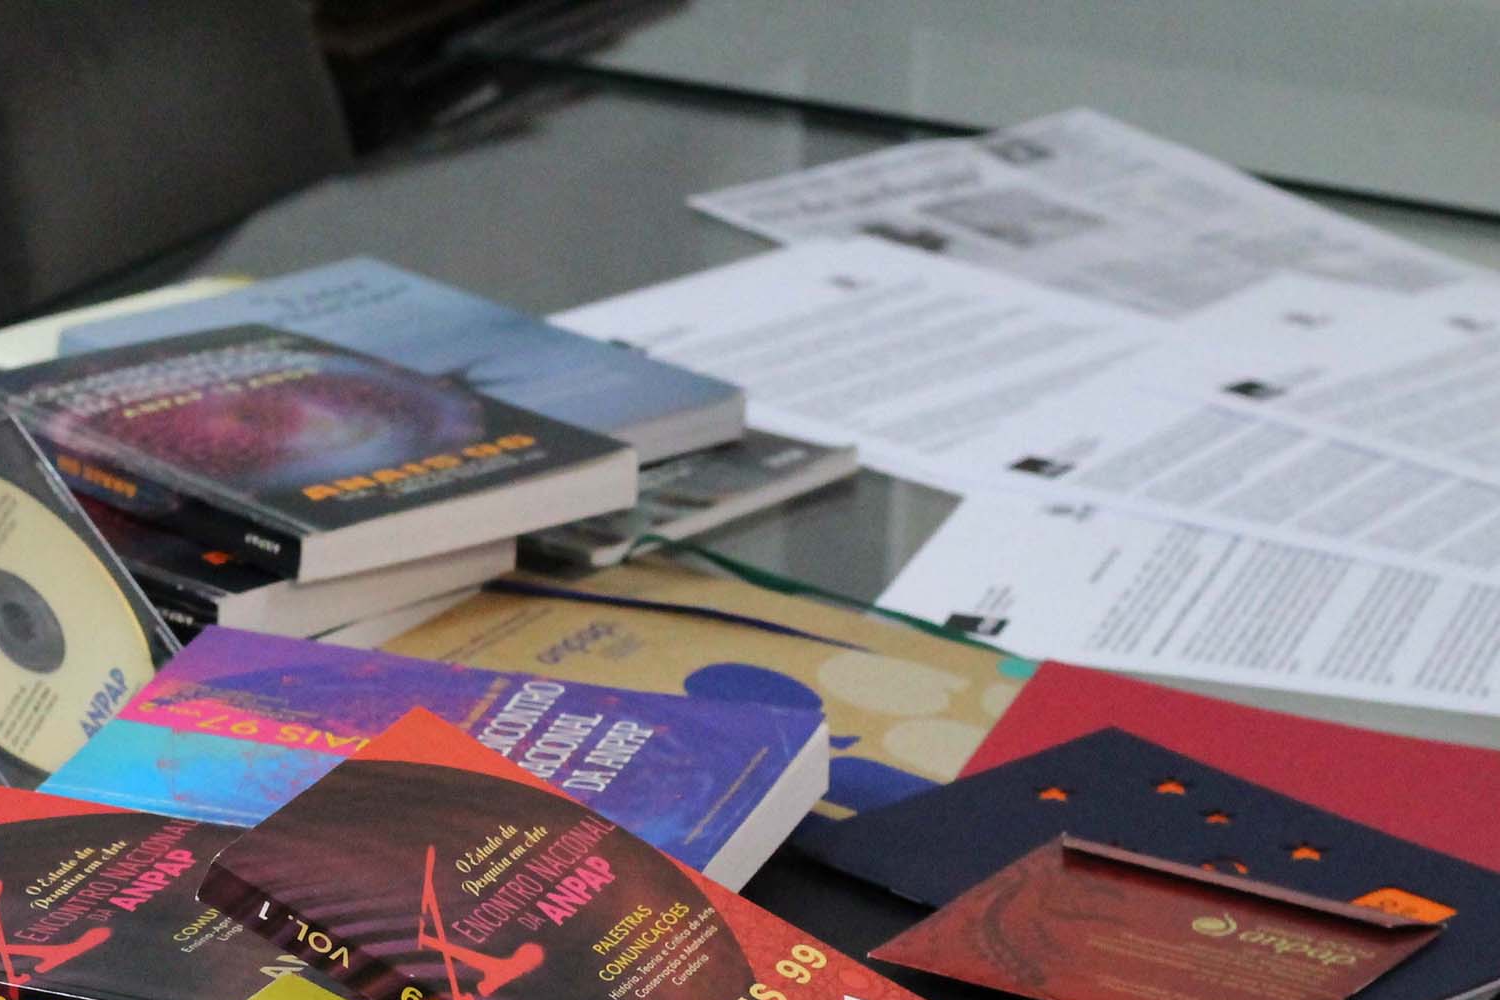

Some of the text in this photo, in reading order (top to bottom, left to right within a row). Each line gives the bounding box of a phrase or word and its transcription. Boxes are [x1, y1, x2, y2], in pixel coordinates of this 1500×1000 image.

[79, 667, 128, 739] ANPAP
[477, 681, 565, 756] NCONTRO
[518, 713, 603, 779] ACIONAL
[584, 721, 654, 770] ANPAP
[562, 770, 617, 792] DA
[455, 823, 519, 874] O Estado da
[461, 856, 512, 897] Pesquisa
[509, 845, 527, 860] em
[14, 820, 199, 943] ENCONTRO NACIONAL
[87, 849, 196, 922] DA ANPAP
[452, 815, 616, 944] ENCONTRO NACIONAL
[518, 856, 616, 931] DA ANPAP
[258, 900, 350, 969] VOL. 1
[592, 904, 653, 956] PALESTRAS
[599, 902, 690, 982] COMUNICAÇÕES
[634, 957, 682, 998] Conservação
[637, 954, 664, 976] Teoria
[671, 953, 710, 986] Curadoria
[775, 943, 828, 984] 99
